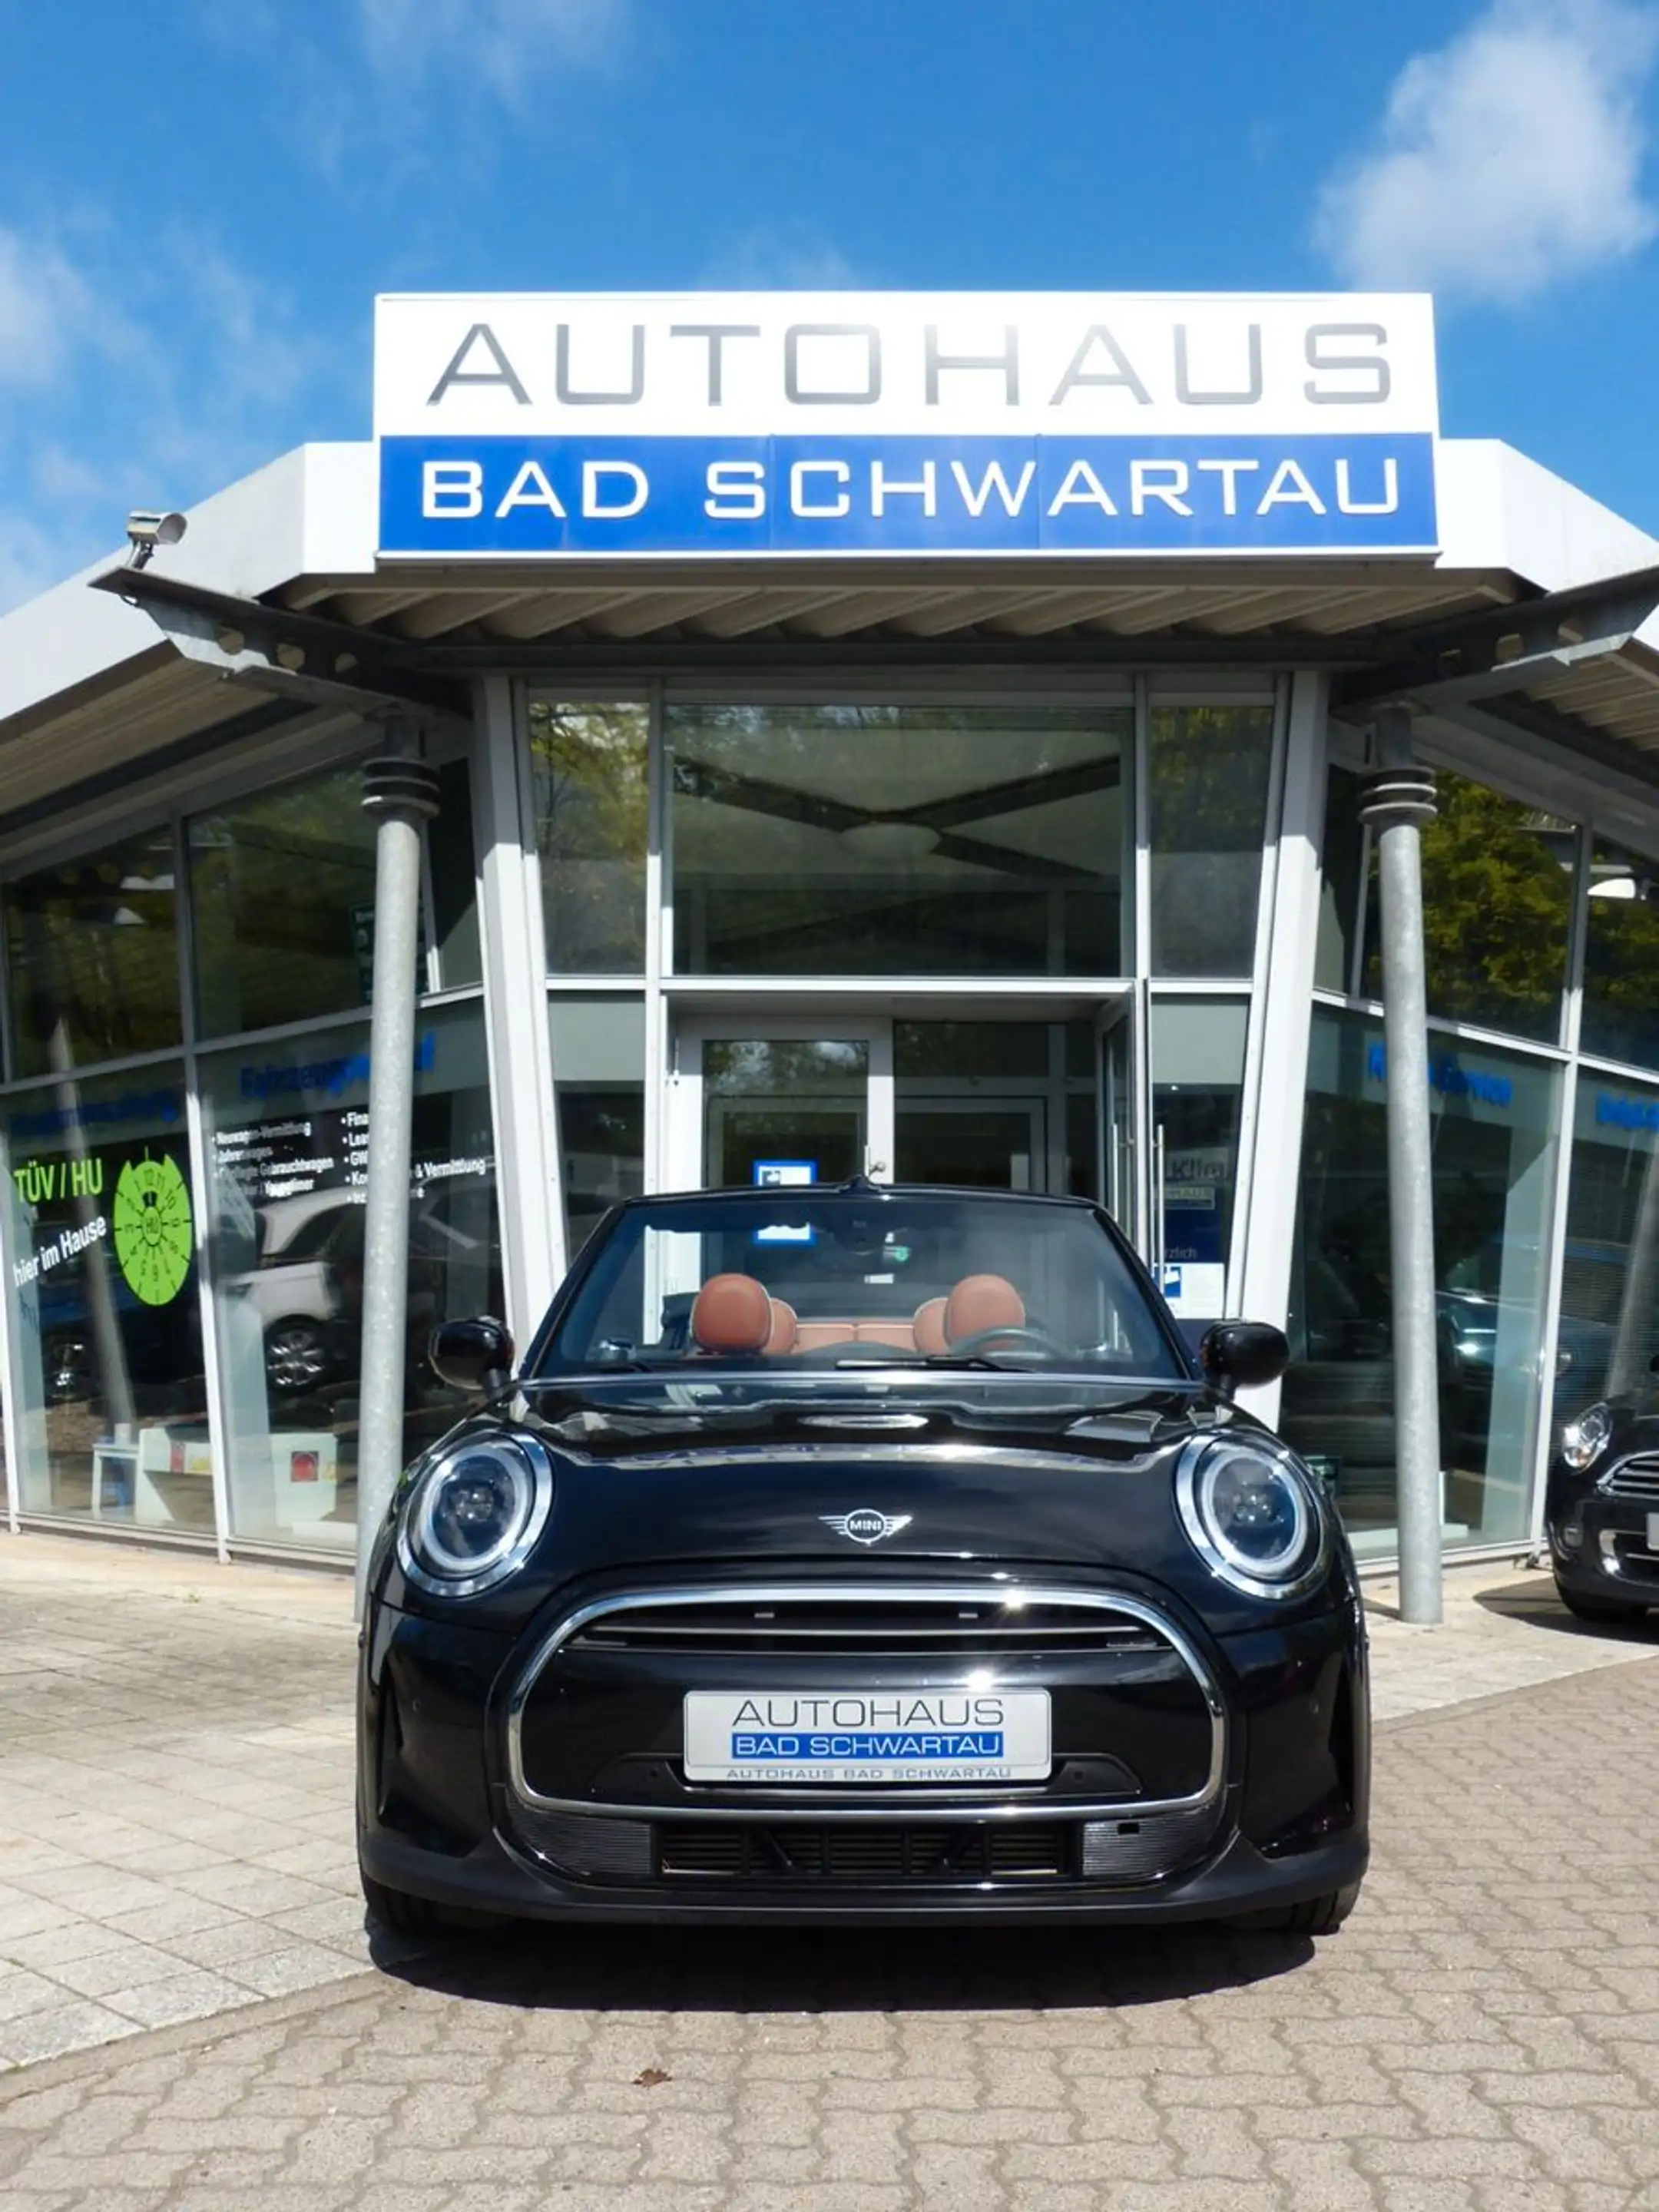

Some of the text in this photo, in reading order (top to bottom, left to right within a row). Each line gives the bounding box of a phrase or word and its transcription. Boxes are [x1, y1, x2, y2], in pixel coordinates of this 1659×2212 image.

[426, 322, 1392, 407] AUTOHAUS
[421, 455, 1401, 519] BAD SCHWARTAU
[13, 1158, 55, 1204] TÜV
[71, 1157, 103, 1197] HU
[425, 1156, 486, 1177] Vermittlung
[12, 1215, 107, 1288] hier im Hause
[849, 1520, 882, 1531] MINI
[732, 1699, 1004, 1727] AUTOHAUS
[735, 1734, 999, 1756] BAD SCHWARTAU
[727, 1767, 1012, 1780] AUTOHAUS BAD SCHWARTAU
